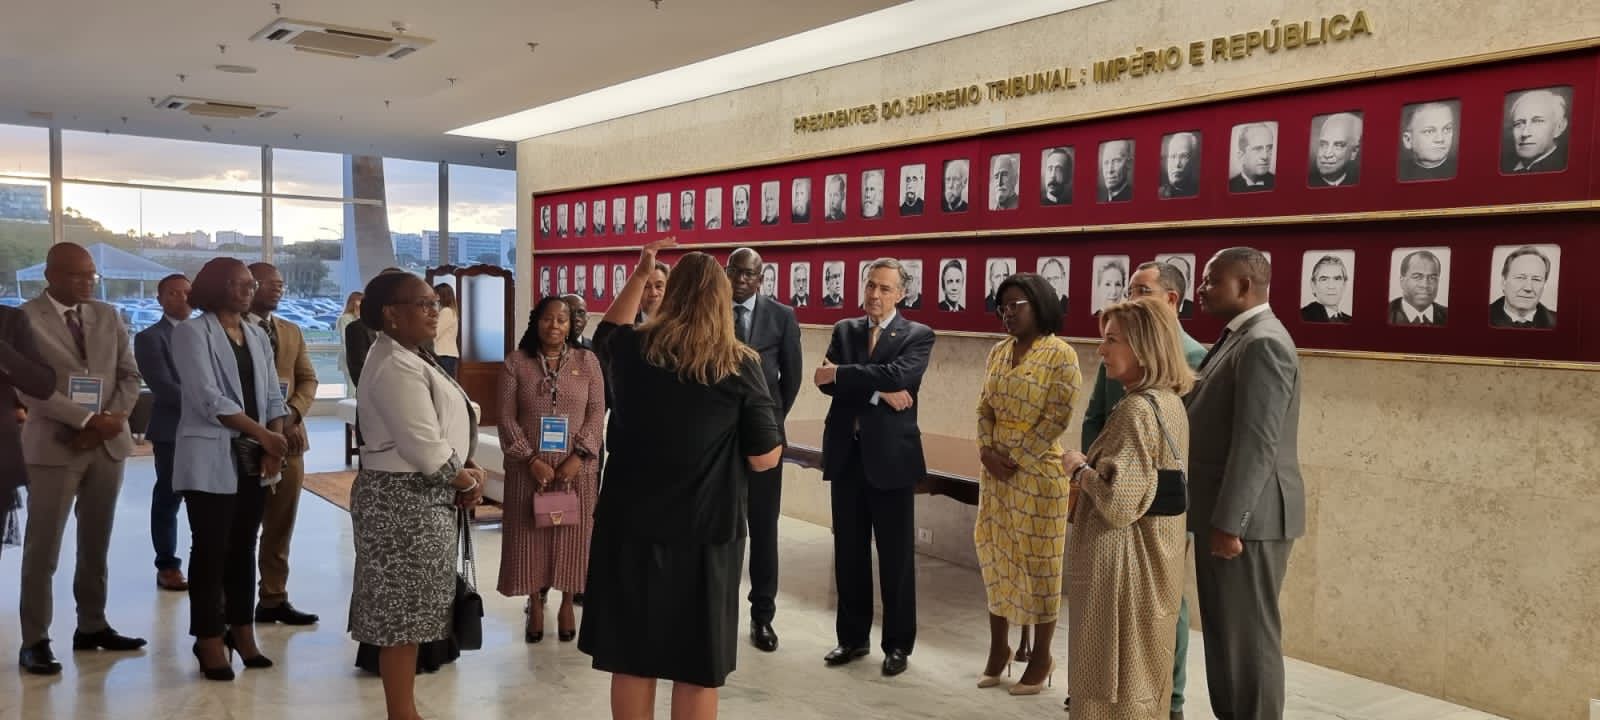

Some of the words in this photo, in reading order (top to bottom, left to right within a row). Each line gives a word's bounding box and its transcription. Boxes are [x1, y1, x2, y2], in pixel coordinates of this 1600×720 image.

[794, 105, 877, 133] PRESIDENTES
[881, 100, 904, 120] DO
[905, 85, 981, 116] SUPREMO
[1093, 46, 1182, 83] IMPÉRIO
[1188, 41, 1205, 66] E
[1211, 10, 1372, 63] REPÚBLICA
